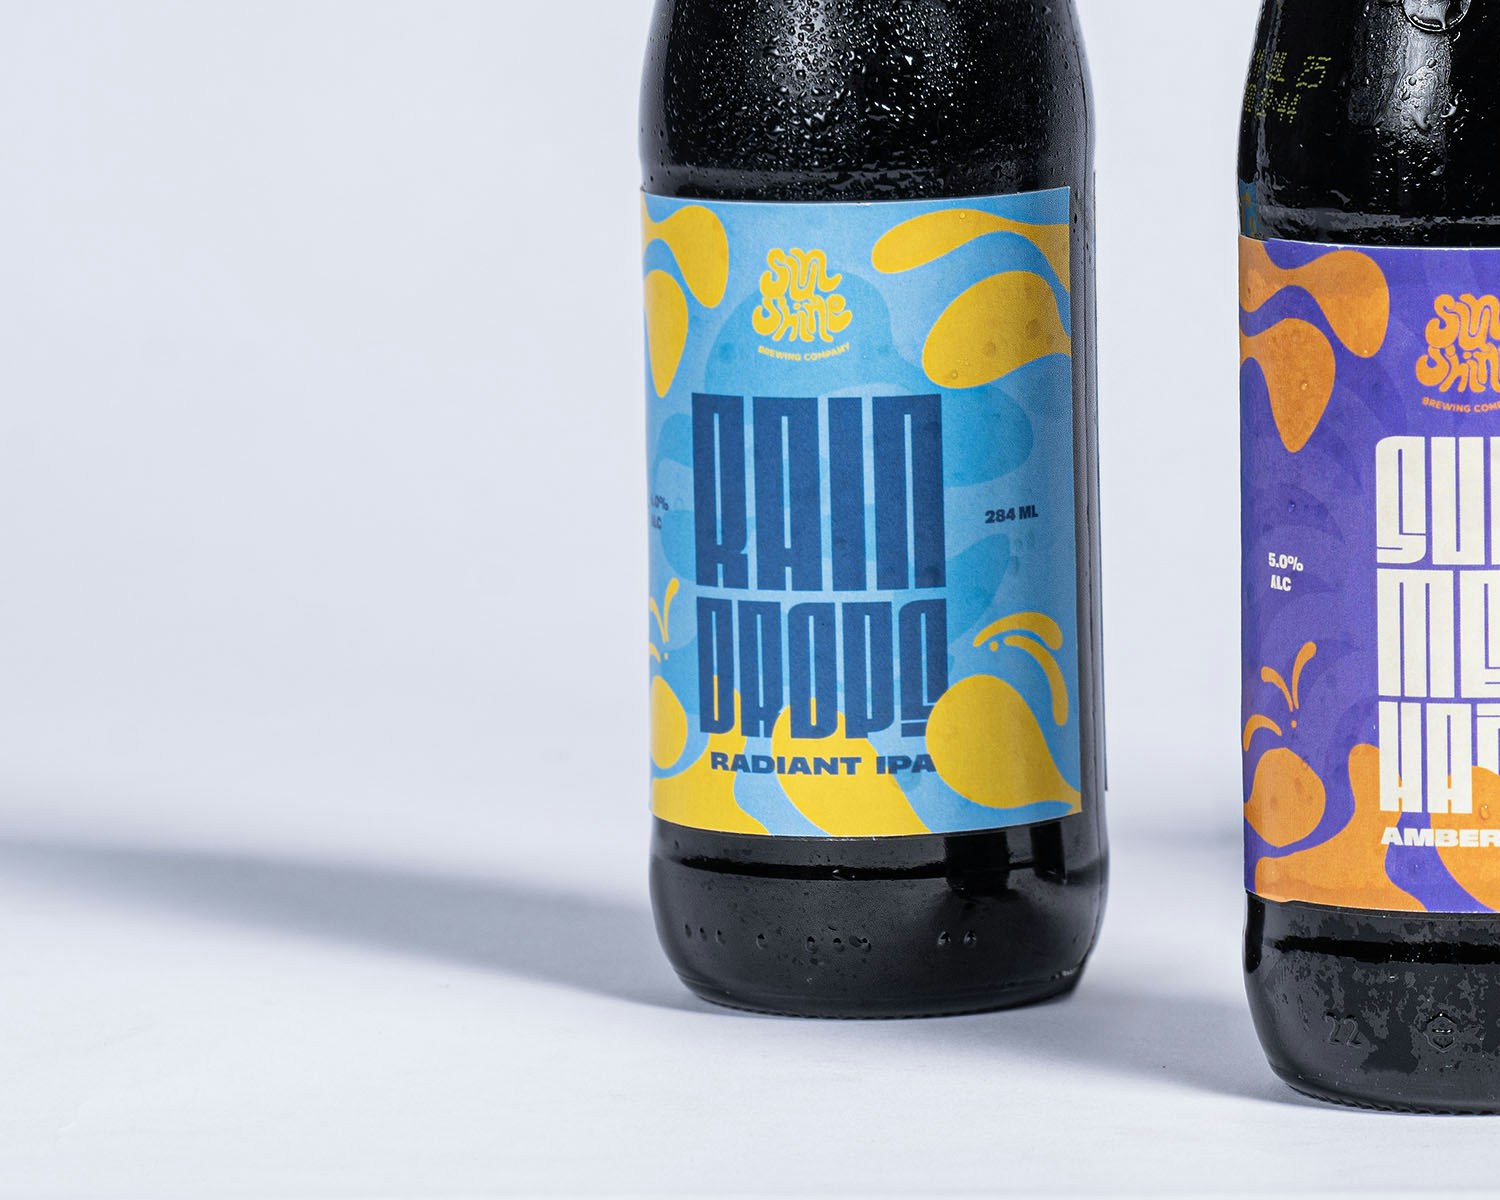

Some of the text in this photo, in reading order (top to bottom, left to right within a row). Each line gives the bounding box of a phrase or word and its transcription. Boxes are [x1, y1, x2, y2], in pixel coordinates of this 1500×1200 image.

[758, 342, 850, 361] BREWING COMPANY
[1422, 397, 1471, 413] BREWING
[691, 392, 947, 591] RAIN
[985, 504, 1039, 524] 284 ML
[1268, 552, 1304, 571] 5.0%
[1270, 574, 1292, 592] ALC
[711, 751, 938, 776] RADIANT IPA
